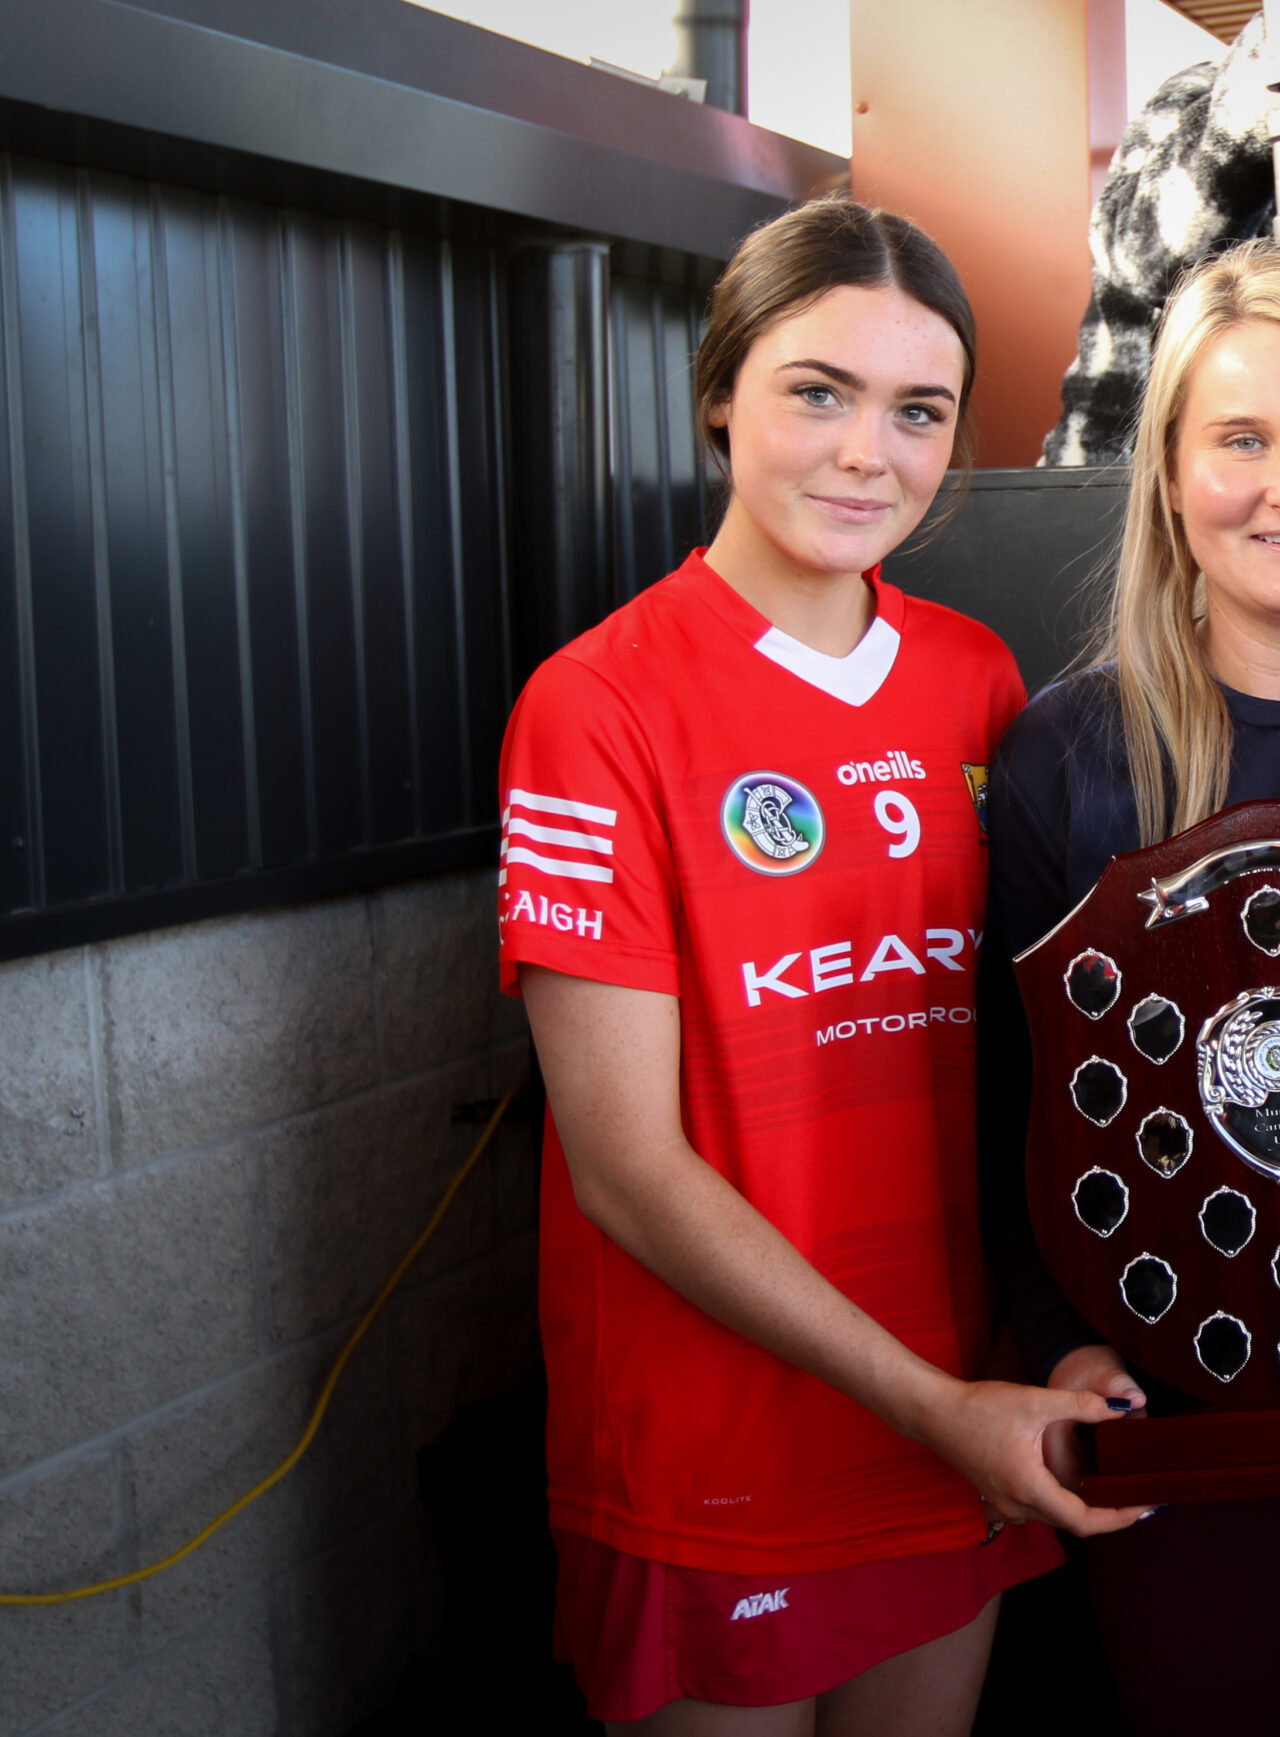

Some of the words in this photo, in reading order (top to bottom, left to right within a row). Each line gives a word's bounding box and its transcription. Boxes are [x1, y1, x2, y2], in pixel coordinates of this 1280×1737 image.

[837, 750, 926, 786] o'neills
[874, 790, 921, 859] 9
[500, 890, 603, 940] AIGH
[703, 1495, 752, 1505] KOOLITE
[730, 1587, 791, 1621] ATAK
